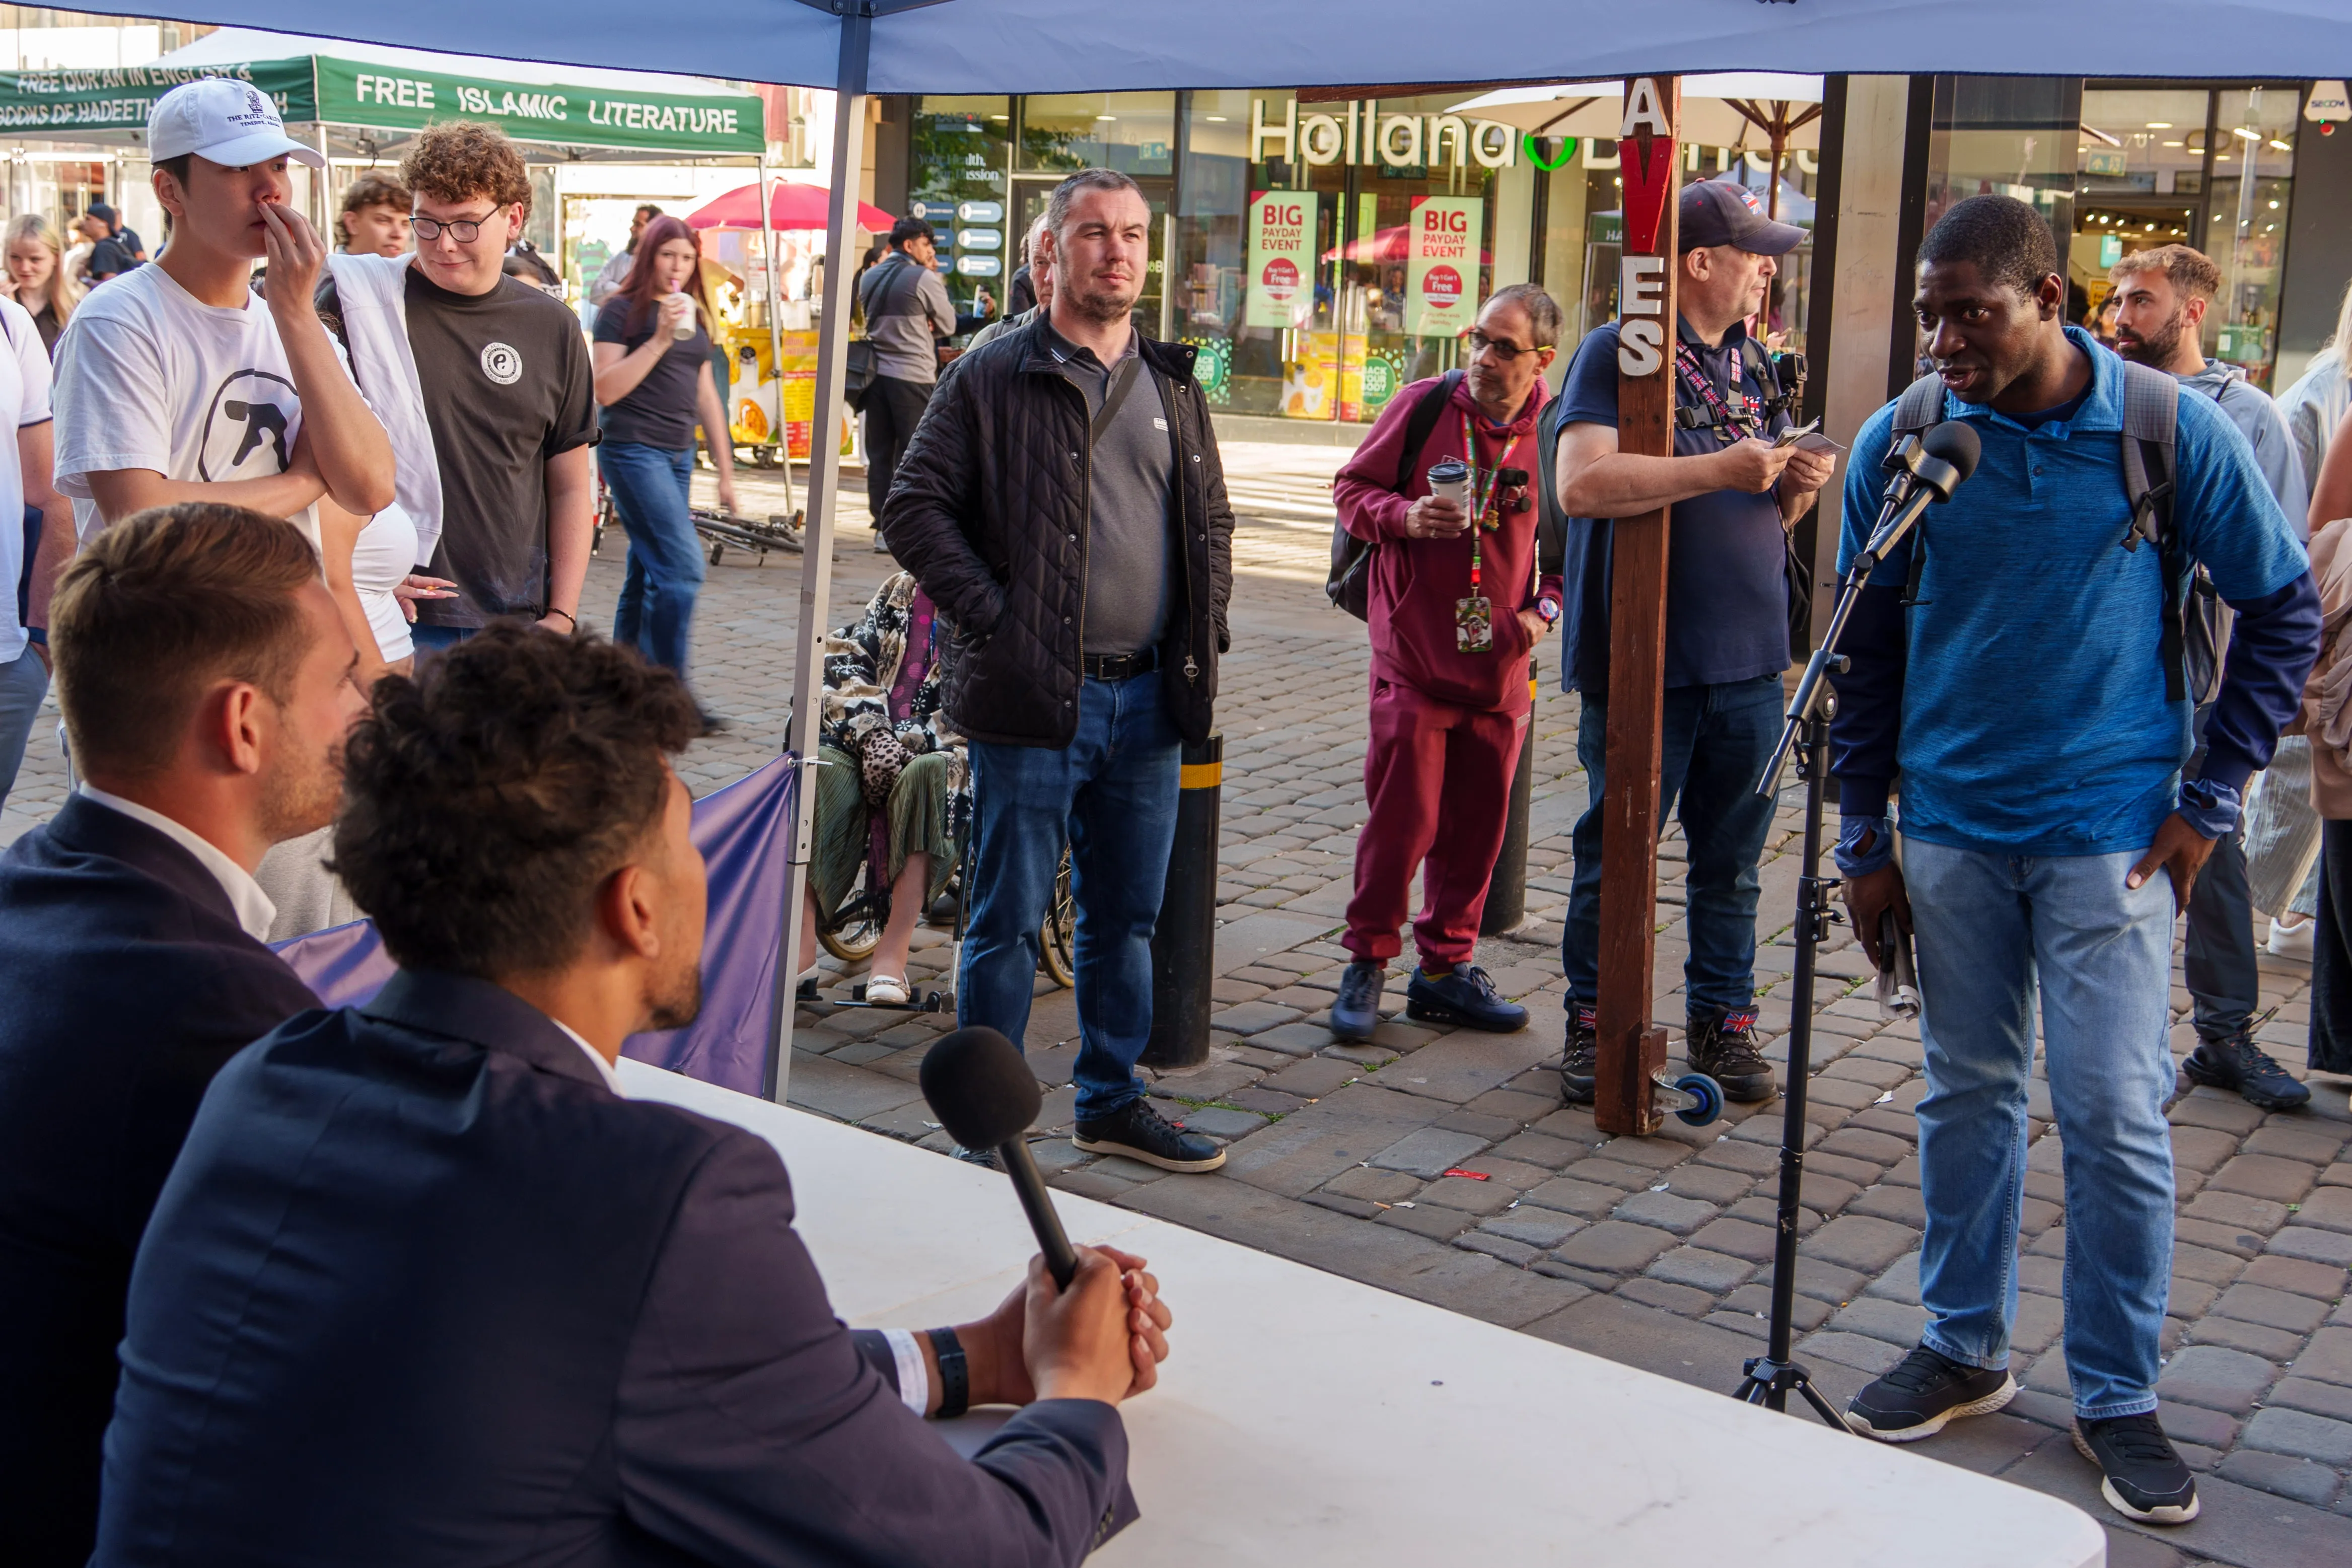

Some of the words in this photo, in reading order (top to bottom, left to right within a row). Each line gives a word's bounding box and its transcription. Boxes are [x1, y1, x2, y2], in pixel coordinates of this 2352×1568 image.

[17, 72, 59, 94] FREE
[63, 68, 126, 93] QUR'AN
[129, 67, 148, 86] IN
[237, 62, 253, 81] &
[51, 102, 75, 124] OF
[76, 98, 159, 123] HADEETH
[356, 74, 435, 109] FREE
[456, 86, 567, 121] ISLAMIC
[588, 99, 738, 134] LITERATURE
[1263, 204, 1303, 226] BIG
[1425, 210, 1466, 233] BIG
[1262, 228, 1302, 238] PAYDAY
[1423, 234, 1466, 244] PAYDAY
[1262, 239, 1302, 251] EVENT
[1422, 246, 1466, 257] EVENT
[1432, 281, 1453, 292] Free
